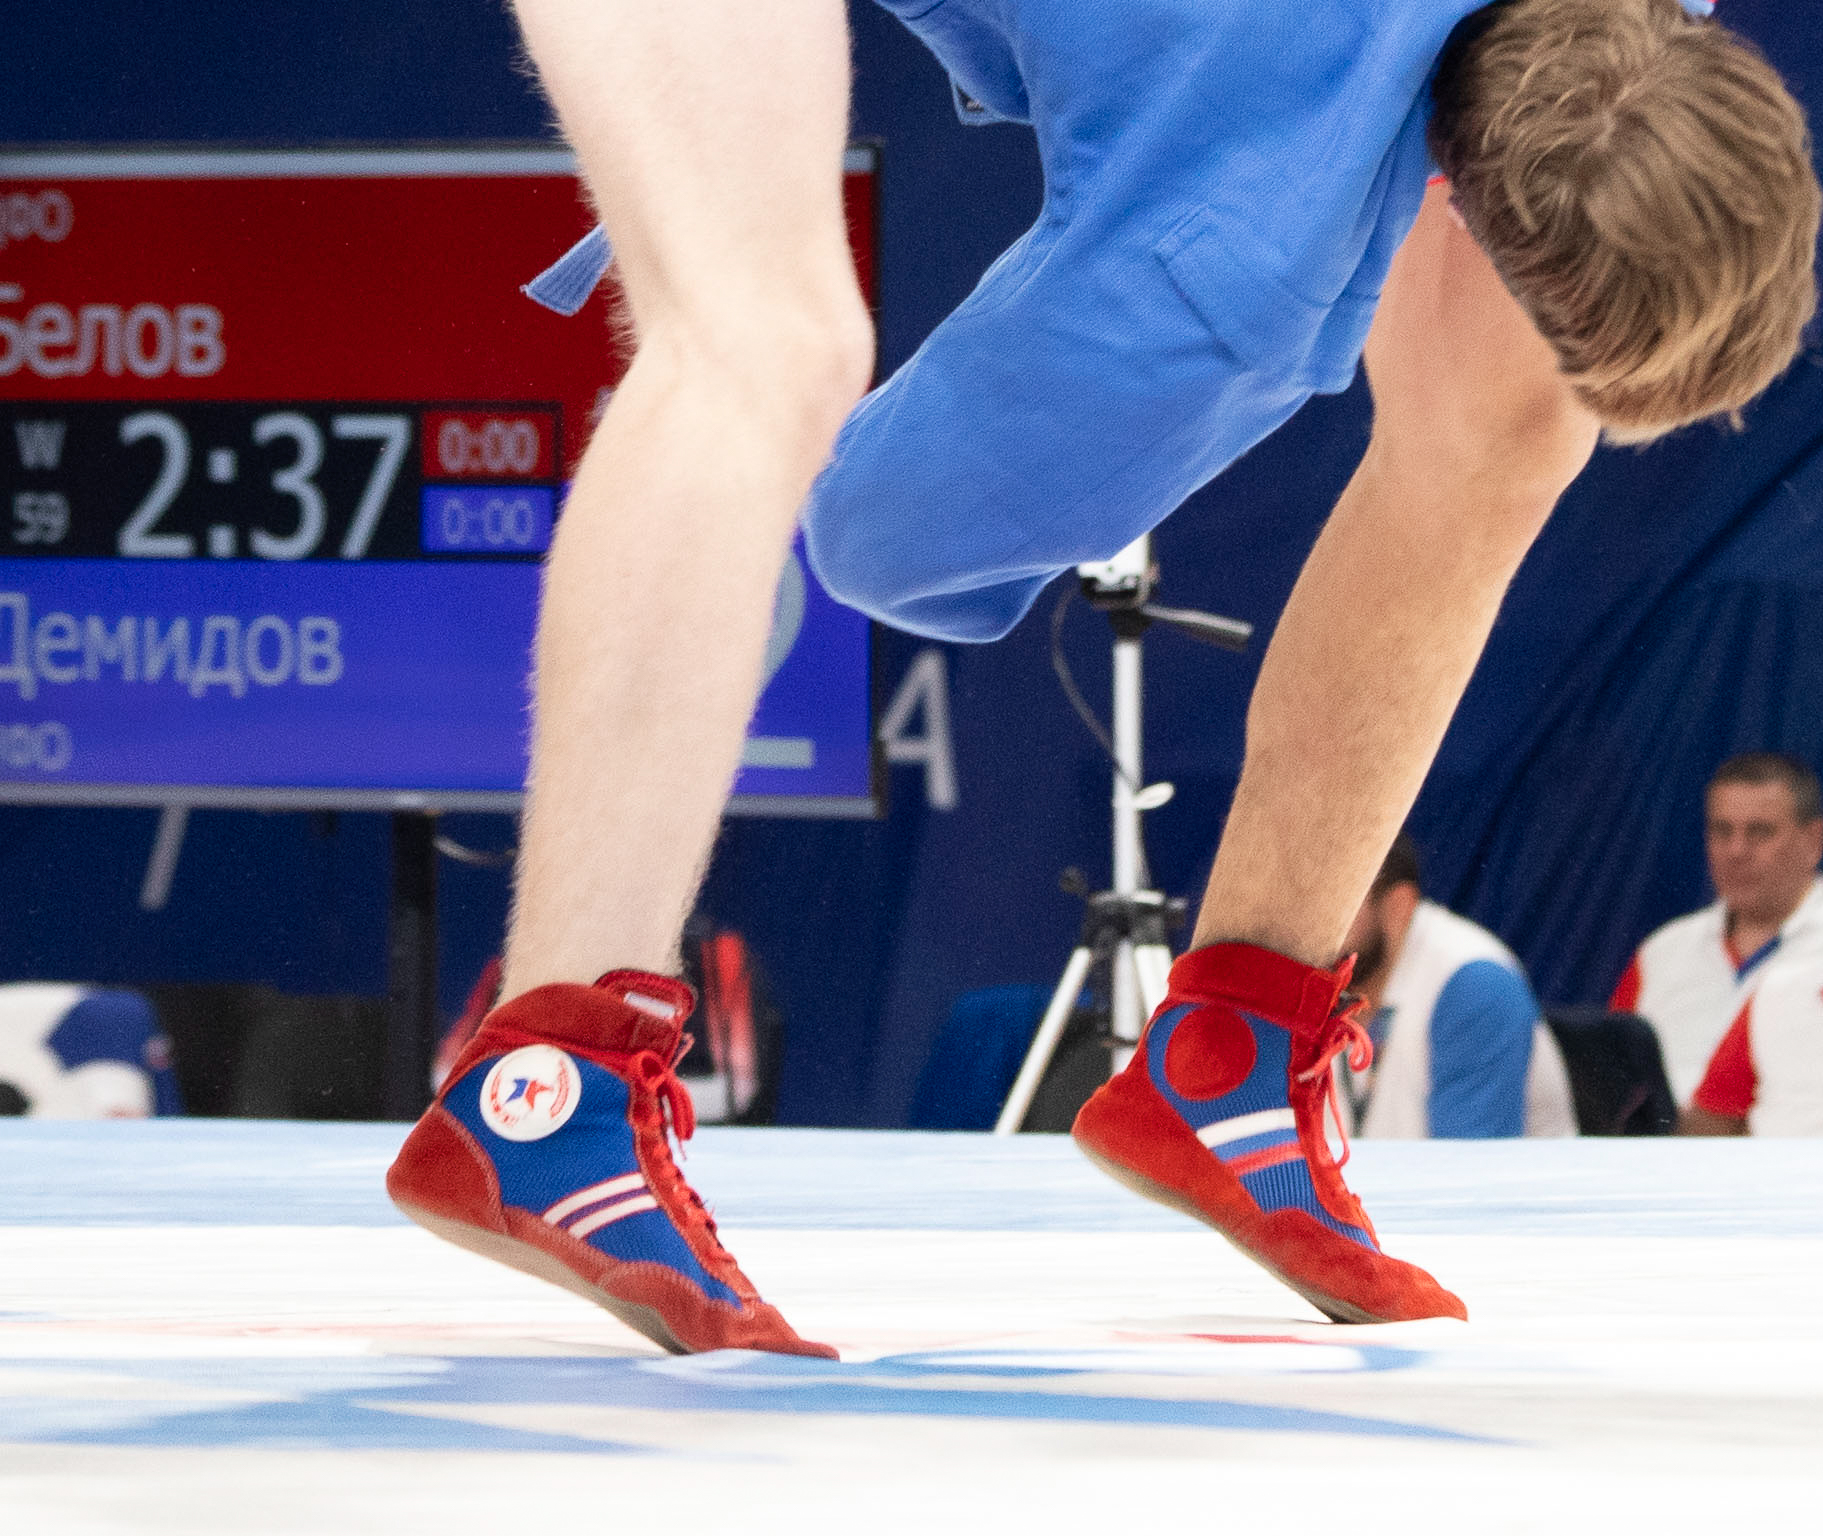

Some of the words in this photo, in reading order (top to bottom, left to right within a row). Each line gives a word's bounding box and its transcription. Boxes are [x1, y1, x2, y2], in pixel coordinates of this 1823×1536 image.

[14, 419, 68, 469] W
[437, 418, 540, 474] 0:00
[117, 410, 413, 560] 2:37
[12, 492, 72, 544] 59
[440, 498, 535, 545] 0:00
